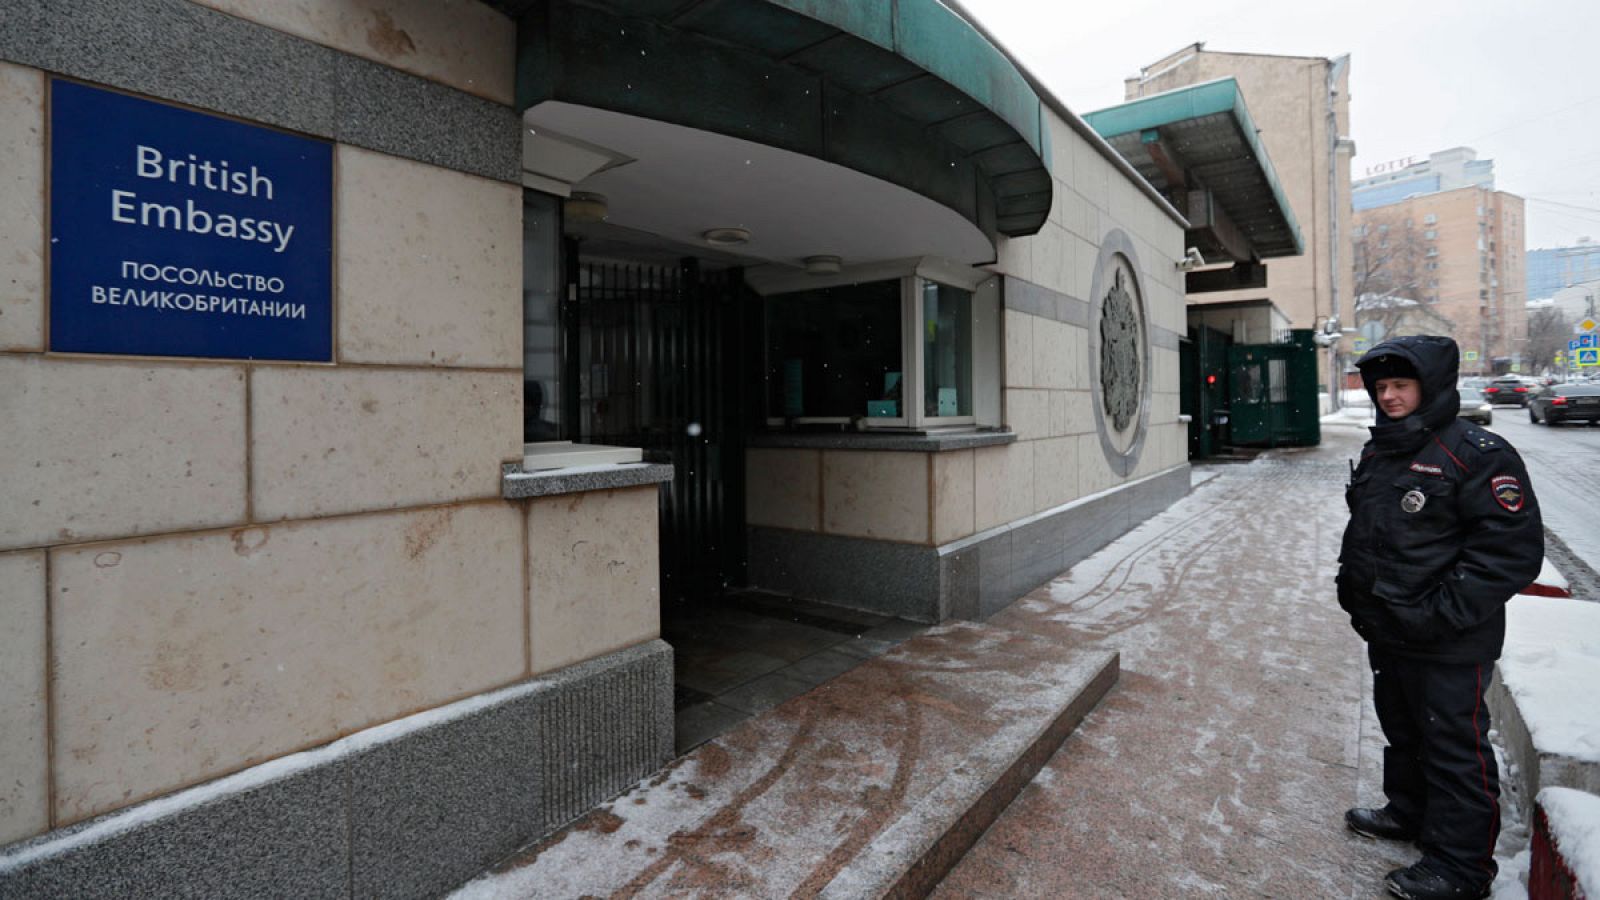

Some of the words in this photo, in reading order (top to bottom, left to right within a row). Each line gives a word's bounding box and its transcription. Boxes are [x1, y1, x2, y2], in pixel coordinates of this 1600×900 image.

[136, 144, 273, 200] British
[1366, 155, 1416, 175] LOTTE
[112, 189, 294, 252] Embassy
[121, 261, 284, 293] ПОСОЛЬСТВО
[91, 286, 306, 319] ВЕЛИКОБРИТАНИИ
